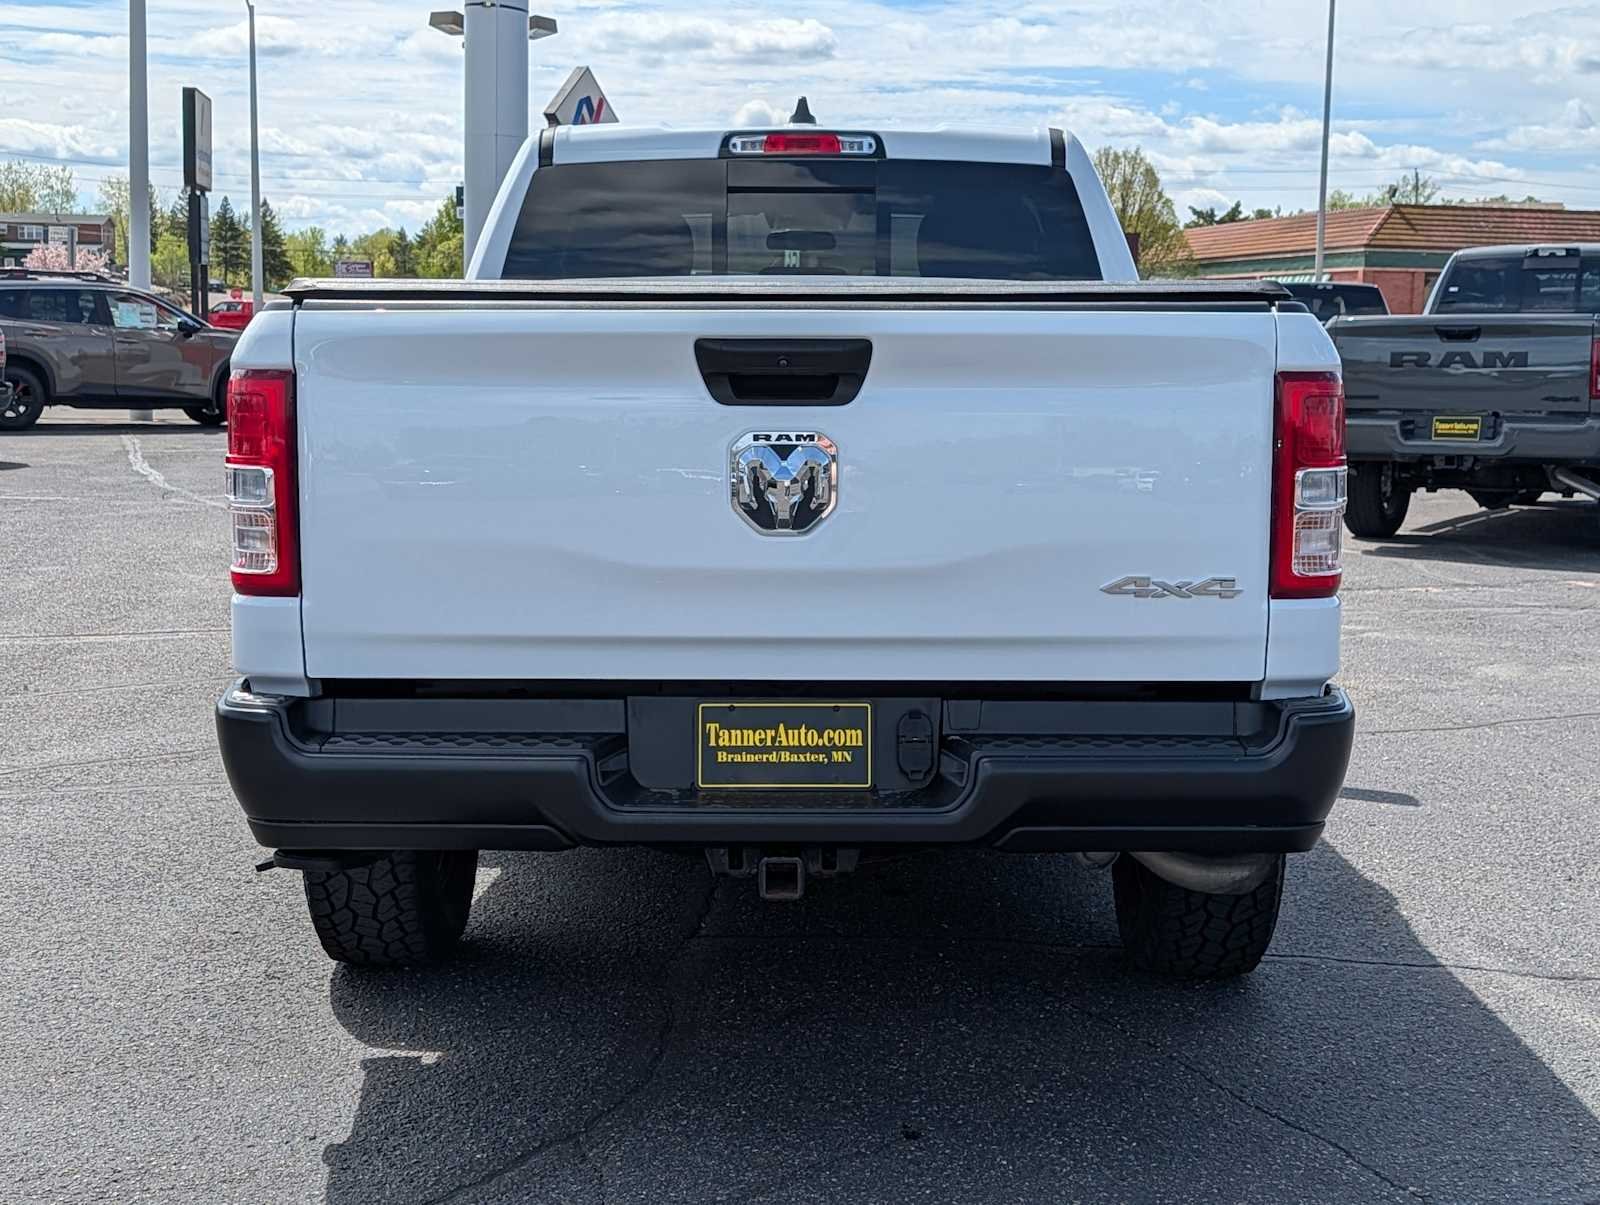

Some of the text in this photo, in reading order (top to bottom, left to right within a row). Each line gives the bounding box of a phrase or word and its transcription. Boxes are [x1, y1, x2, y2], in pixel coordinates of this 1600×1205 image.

[1390, 351, 1528, 368] RAM
[753, 434, 815, 442] RAM
[1099, 576, 1244, 599] 4x4
[706, 722, 863, 747] TannerAuto.com
[717, 751, 852, 764] Brainerd/Baxter, MN
